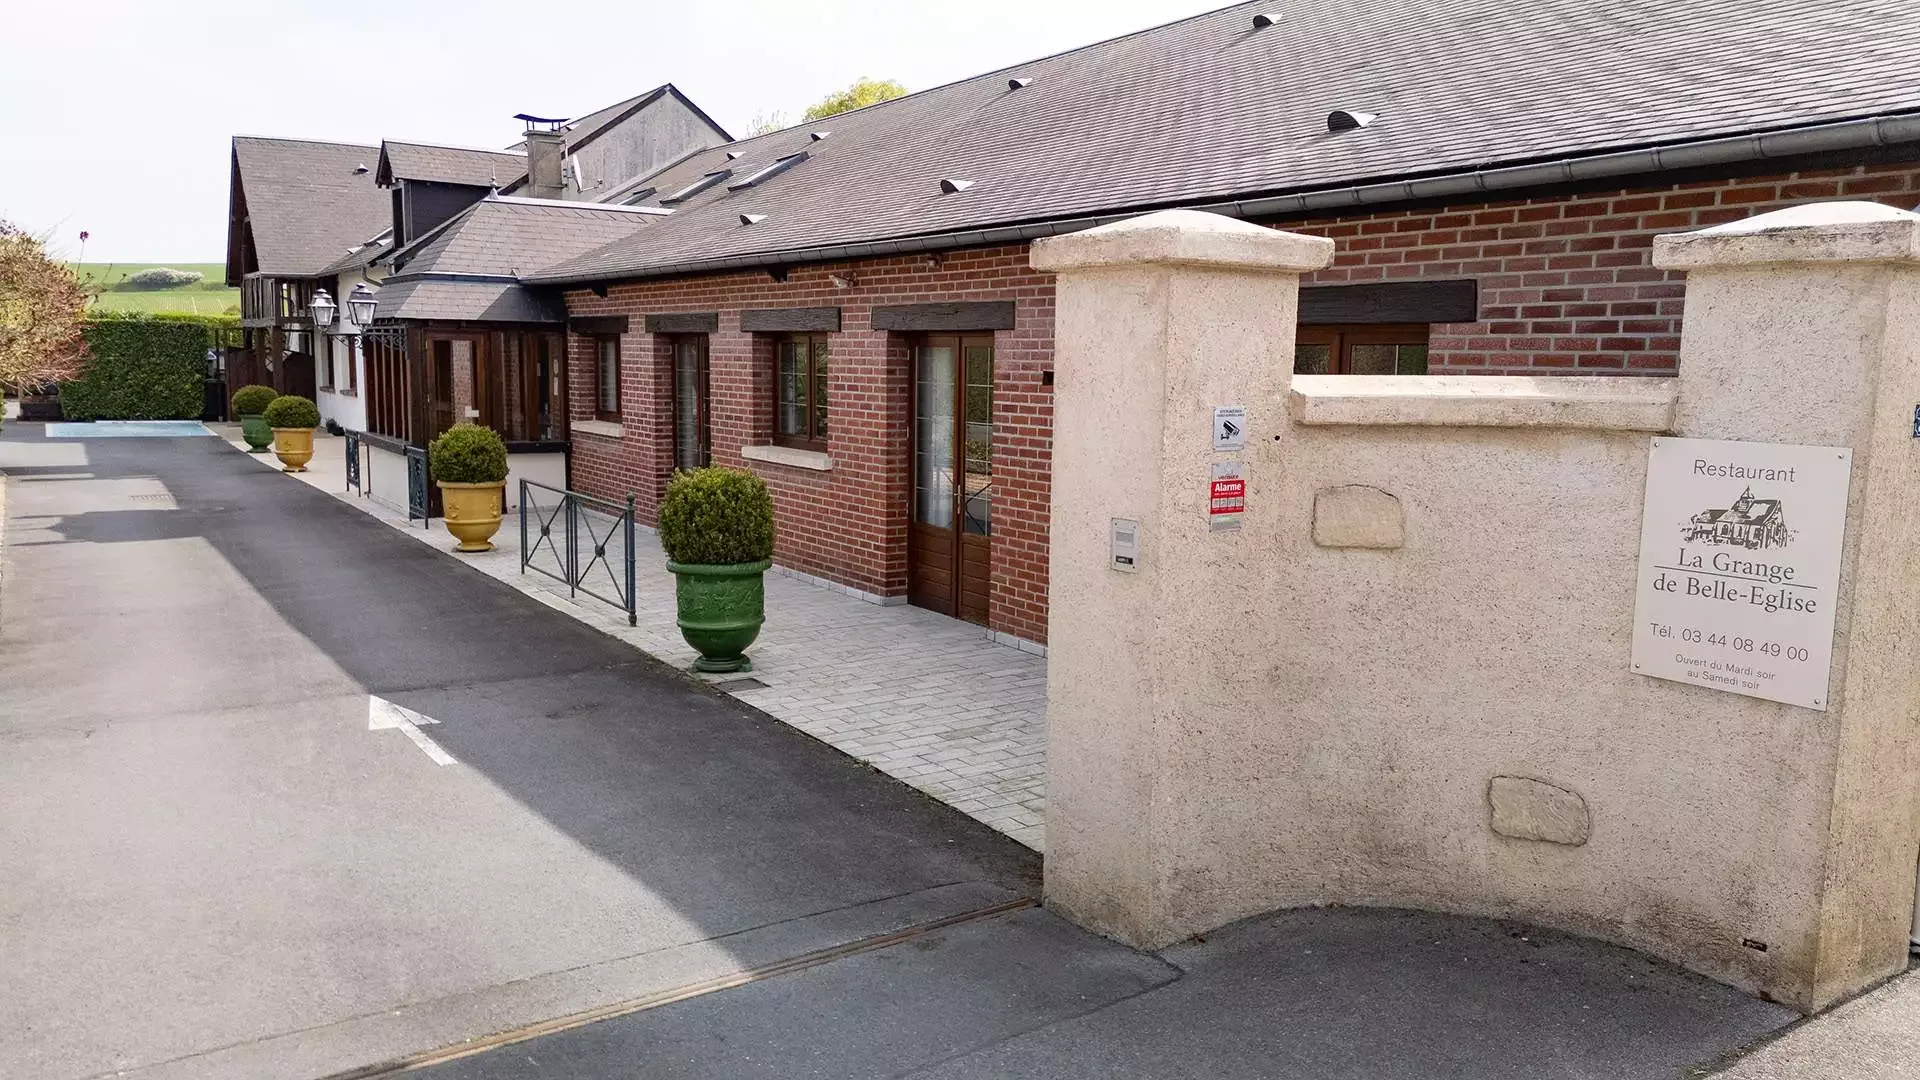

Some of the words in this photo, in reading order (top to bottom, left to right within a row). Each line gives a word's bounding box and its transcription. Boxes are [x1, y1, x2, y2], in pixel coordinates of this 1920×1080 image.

[1693, 459, 1796, 482] Restaurant
[1215, 483, 1242, 492] Alarme
[1678, 548, 1703, 568] La
[1712, 552, 1795, 584] Grange
[1653, 573, 1677, 592] de
[1686, 577, 1817, 613] Belle-Eglise
[1650, 623, 1675, 639] Tél.
[1682, 628, 1702, 643] 03
[1707, 632, 1726, 647] 44
[1733, 637, 1754, 652] 08
[1760, 642, 1781, 657] 49
[1787, 646, 1808, 662] 00
[1675, 654, 1707, 667] Ouvert
[1710, 660, 1723, 669] du
[1725, 662, 1753, 676] Mardi
[1756, 669, 1775, 680] soir
[1702, 671, 1739, 687] Samedi
[1742, 677, 1760, 689] soir
